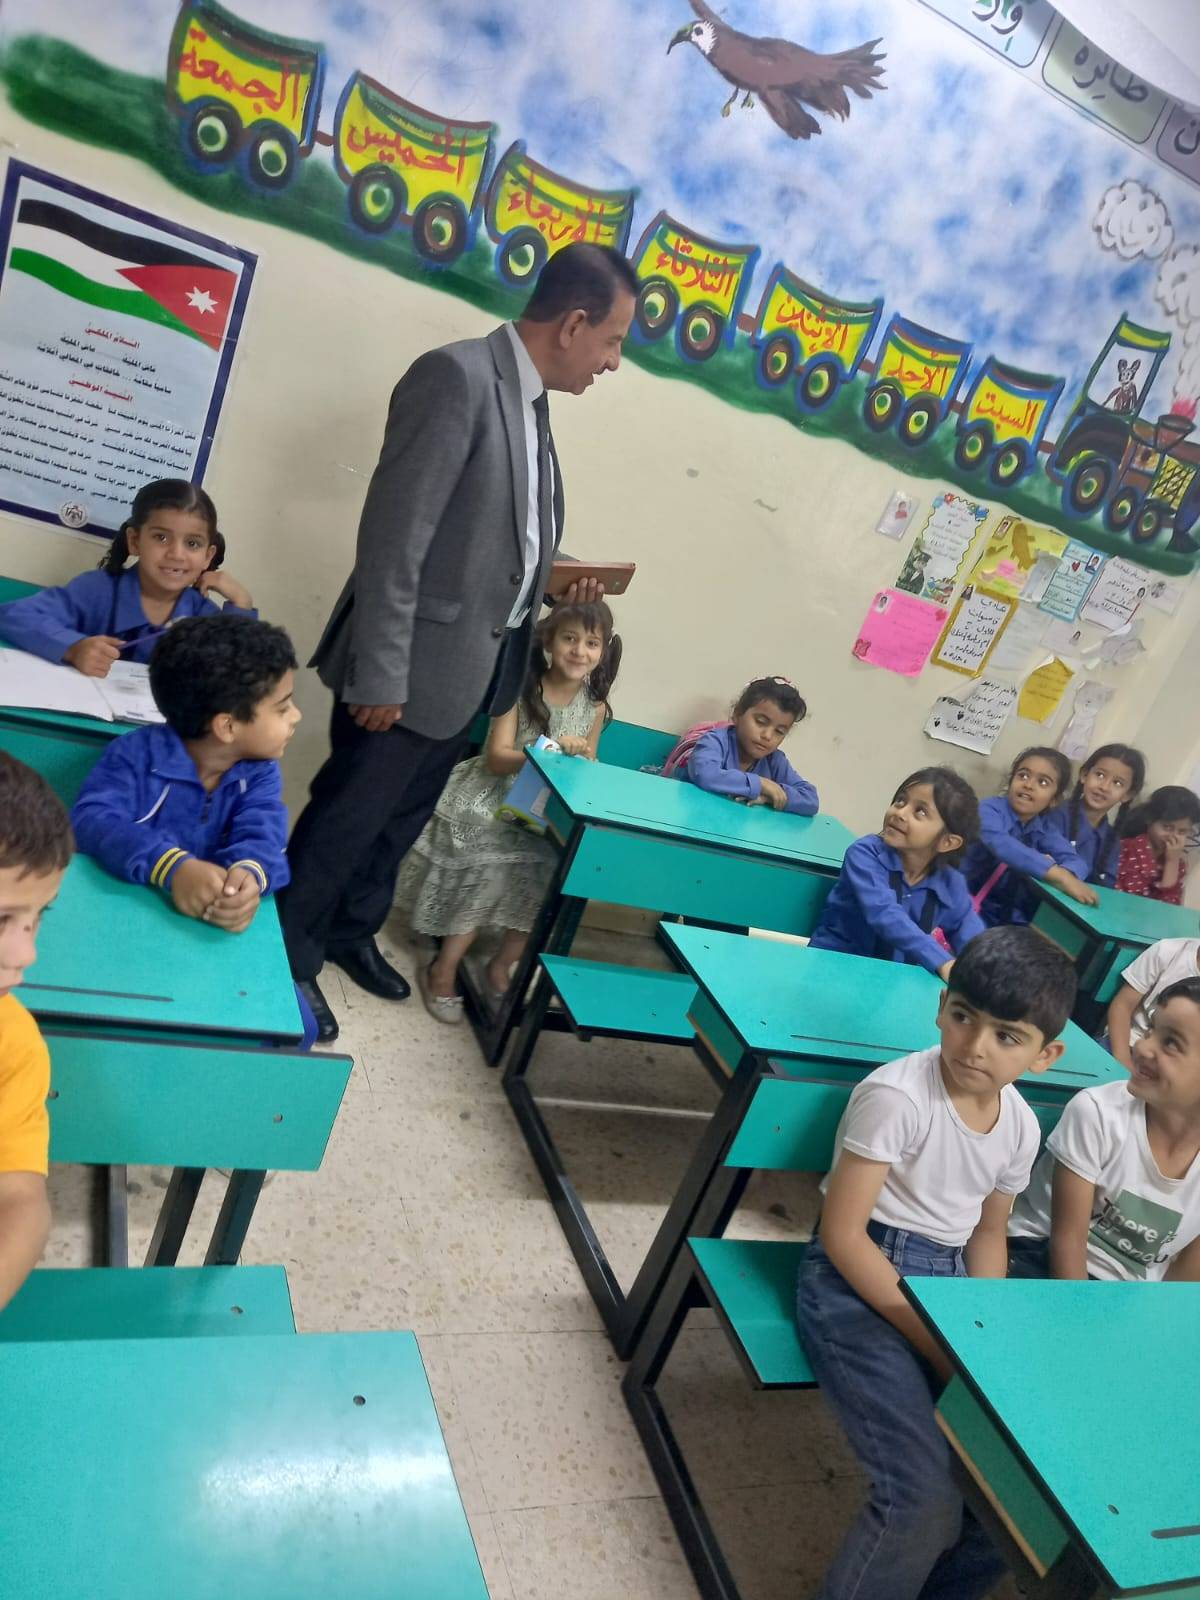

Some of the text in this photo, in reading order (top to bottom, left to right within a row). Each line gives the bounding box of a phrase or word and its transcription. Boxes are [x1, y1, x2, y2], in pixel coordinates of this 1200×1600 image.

[179, 27, 301, 120] الجمعة
[347, 126, 467, 185] الخميس
[656, 236, 736, 297] الثلاثاء
[976, 392, 1038, 435] السبت
